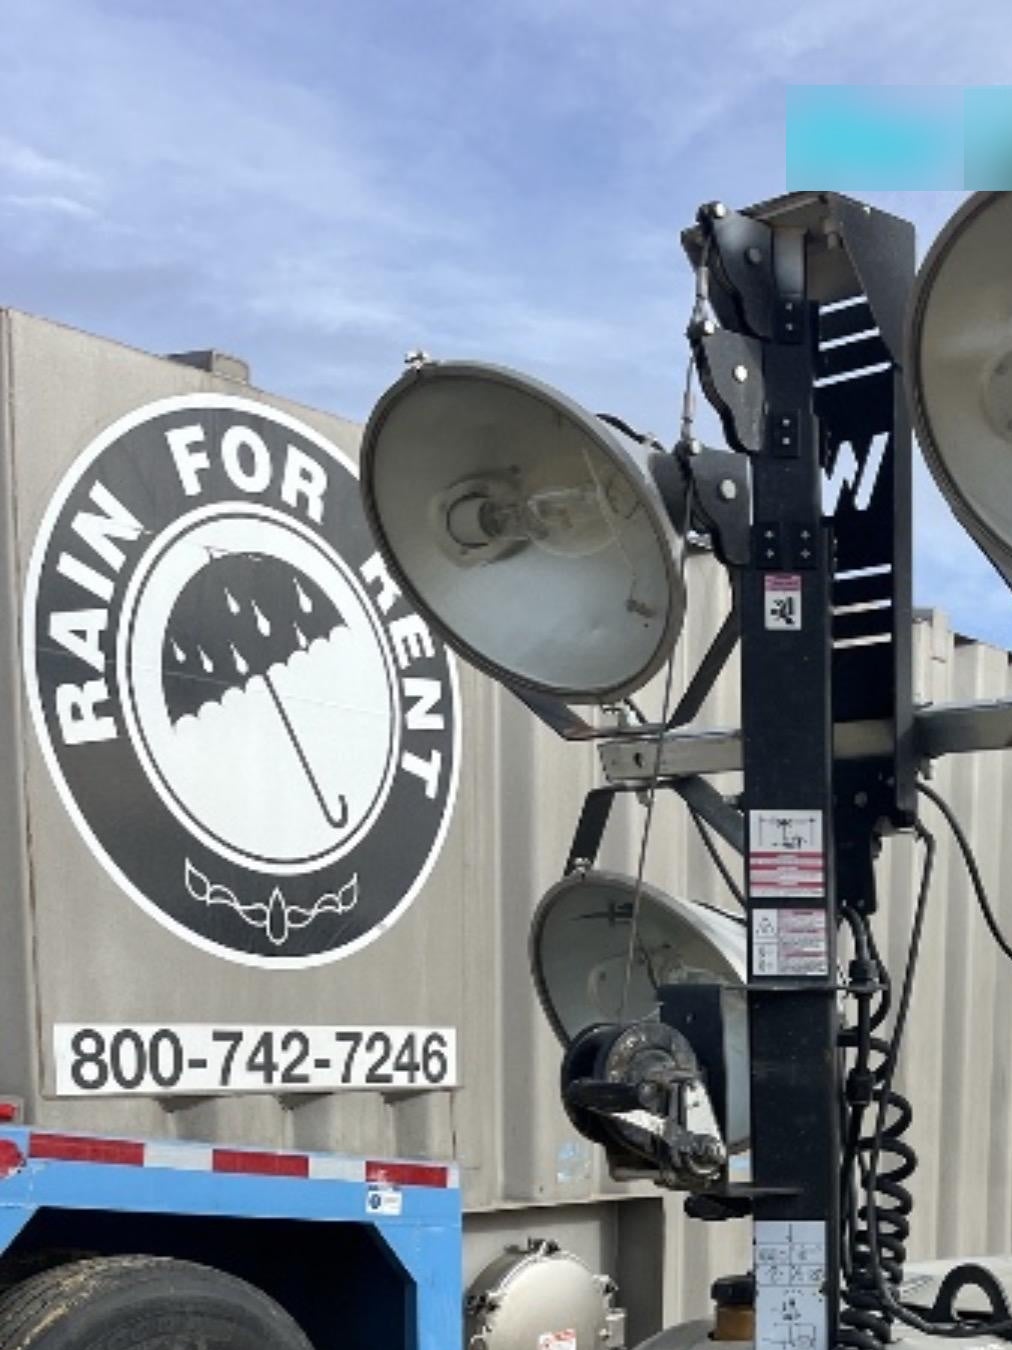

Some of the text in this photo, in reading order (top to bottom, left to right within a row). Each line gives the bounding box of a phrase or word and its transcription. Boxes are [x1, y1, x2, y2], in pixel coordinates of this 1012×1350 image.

[48, 479, 146, 745] RAIN
[165, 425, 328, 525] FOR
[72, 1028, 449, 1090] 800-742-7246
